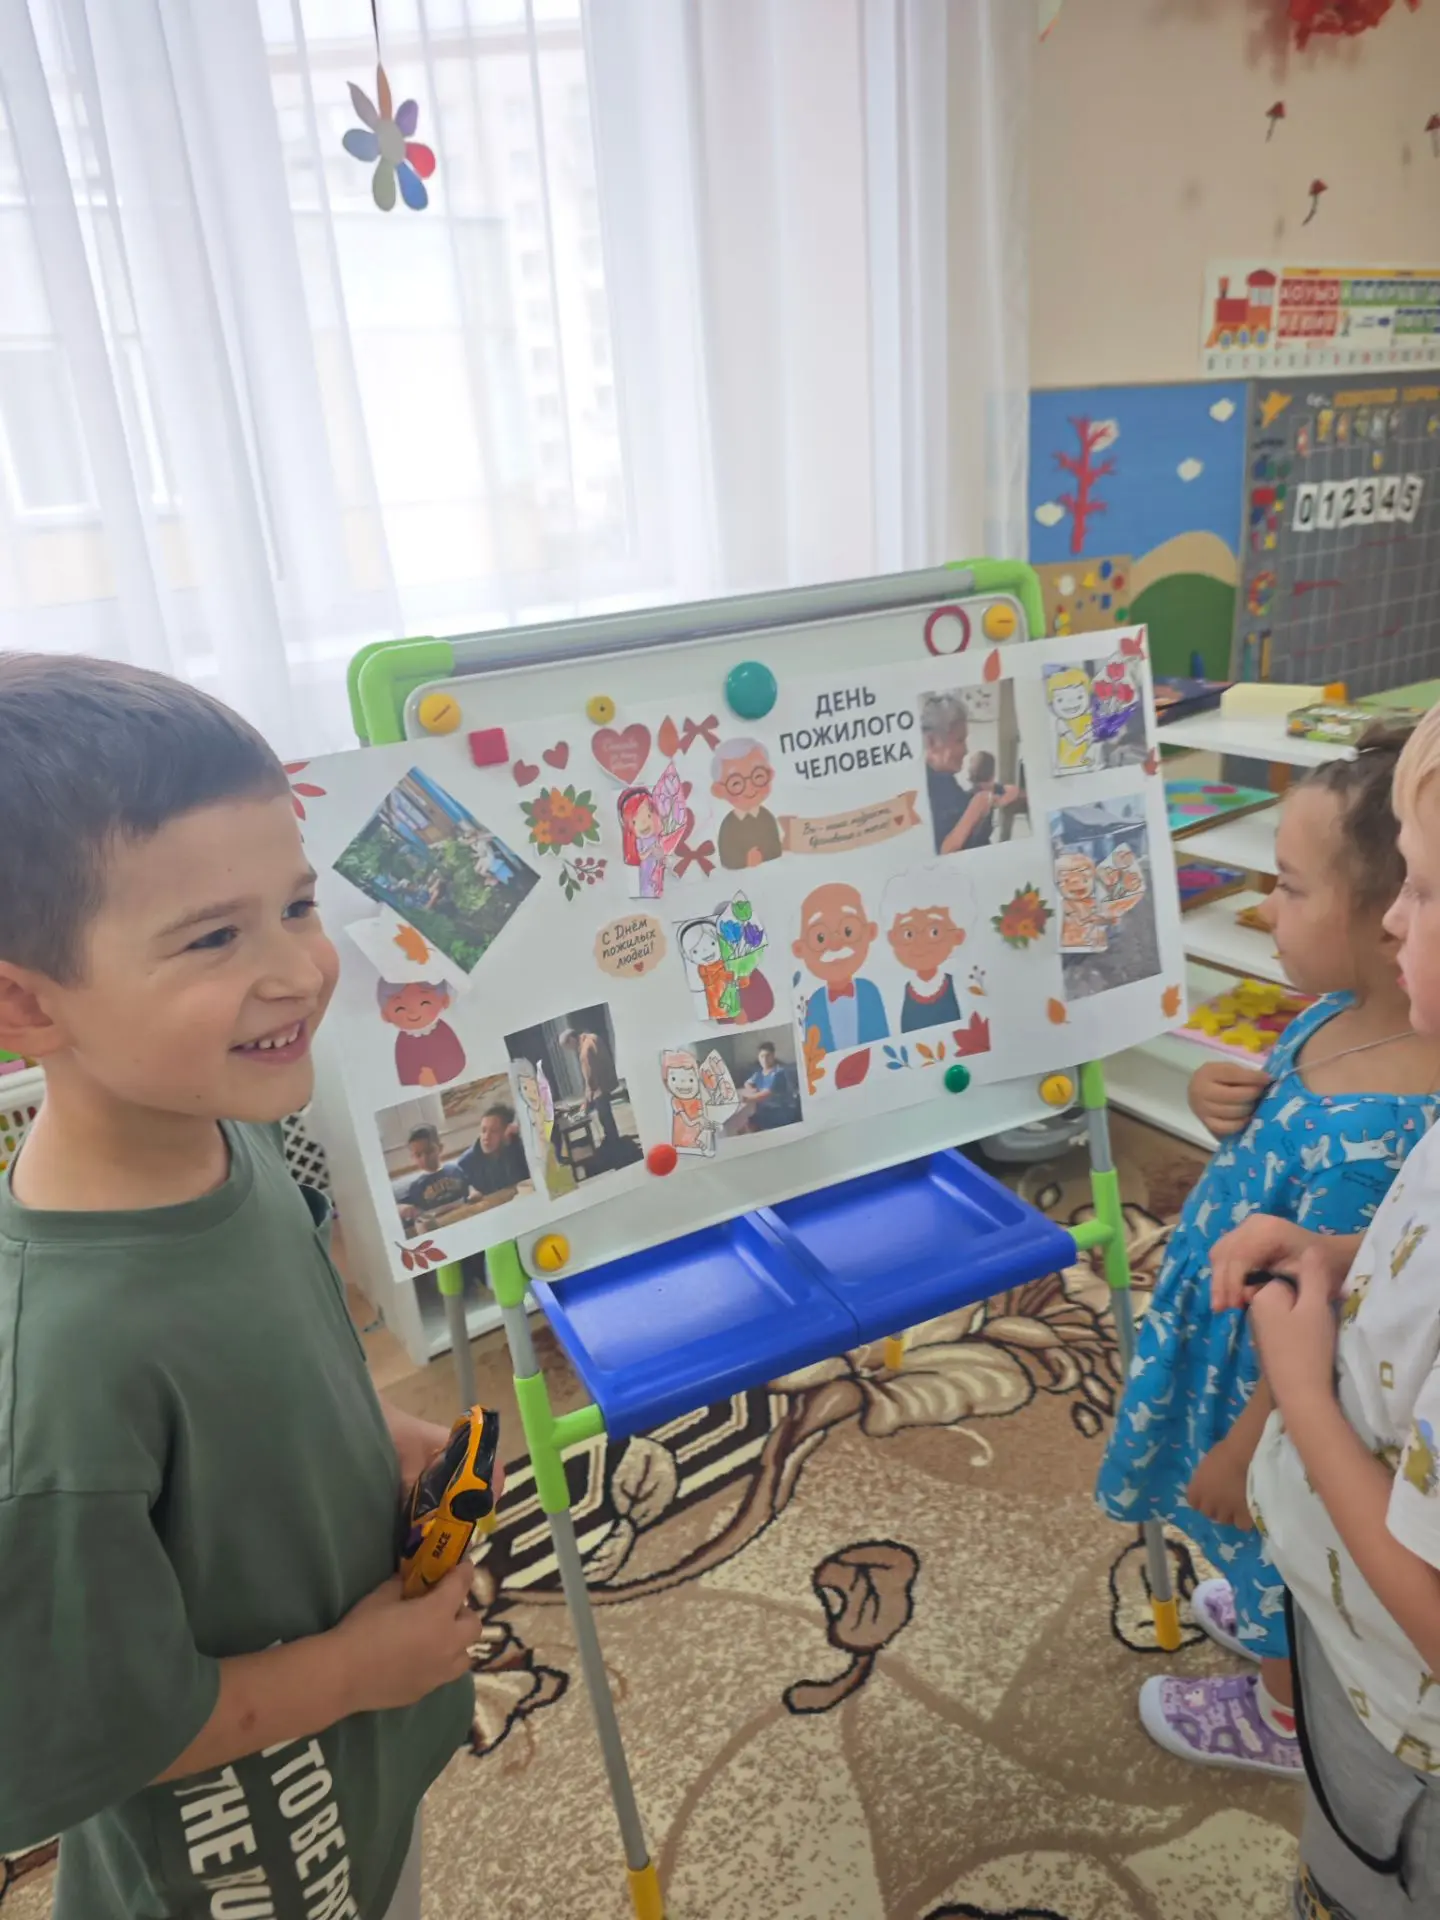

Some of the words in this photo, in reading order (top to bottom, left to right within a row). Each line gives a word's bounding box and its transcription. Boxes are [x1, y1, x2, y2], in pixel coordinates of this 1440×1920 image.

[815, 686, 876, 719] ДЕНЬ
[779, 710, 914, 754] ПОЖИЛОГО
[795, 741, 913, 780] ЧЕЛОВЕКА
[601, 931, 611, 946] С
[614, 919, 648, 940] Днём
[602, 928, 656, 959] пожилых
[616, 940, 654, 969] людей!
[432, 1532, 452, 1559] RACE
[271, 1738, 333, 1819] TO
[173, 1765, 258, 1875] THE
[289, 1801, 346, 1881] BE
